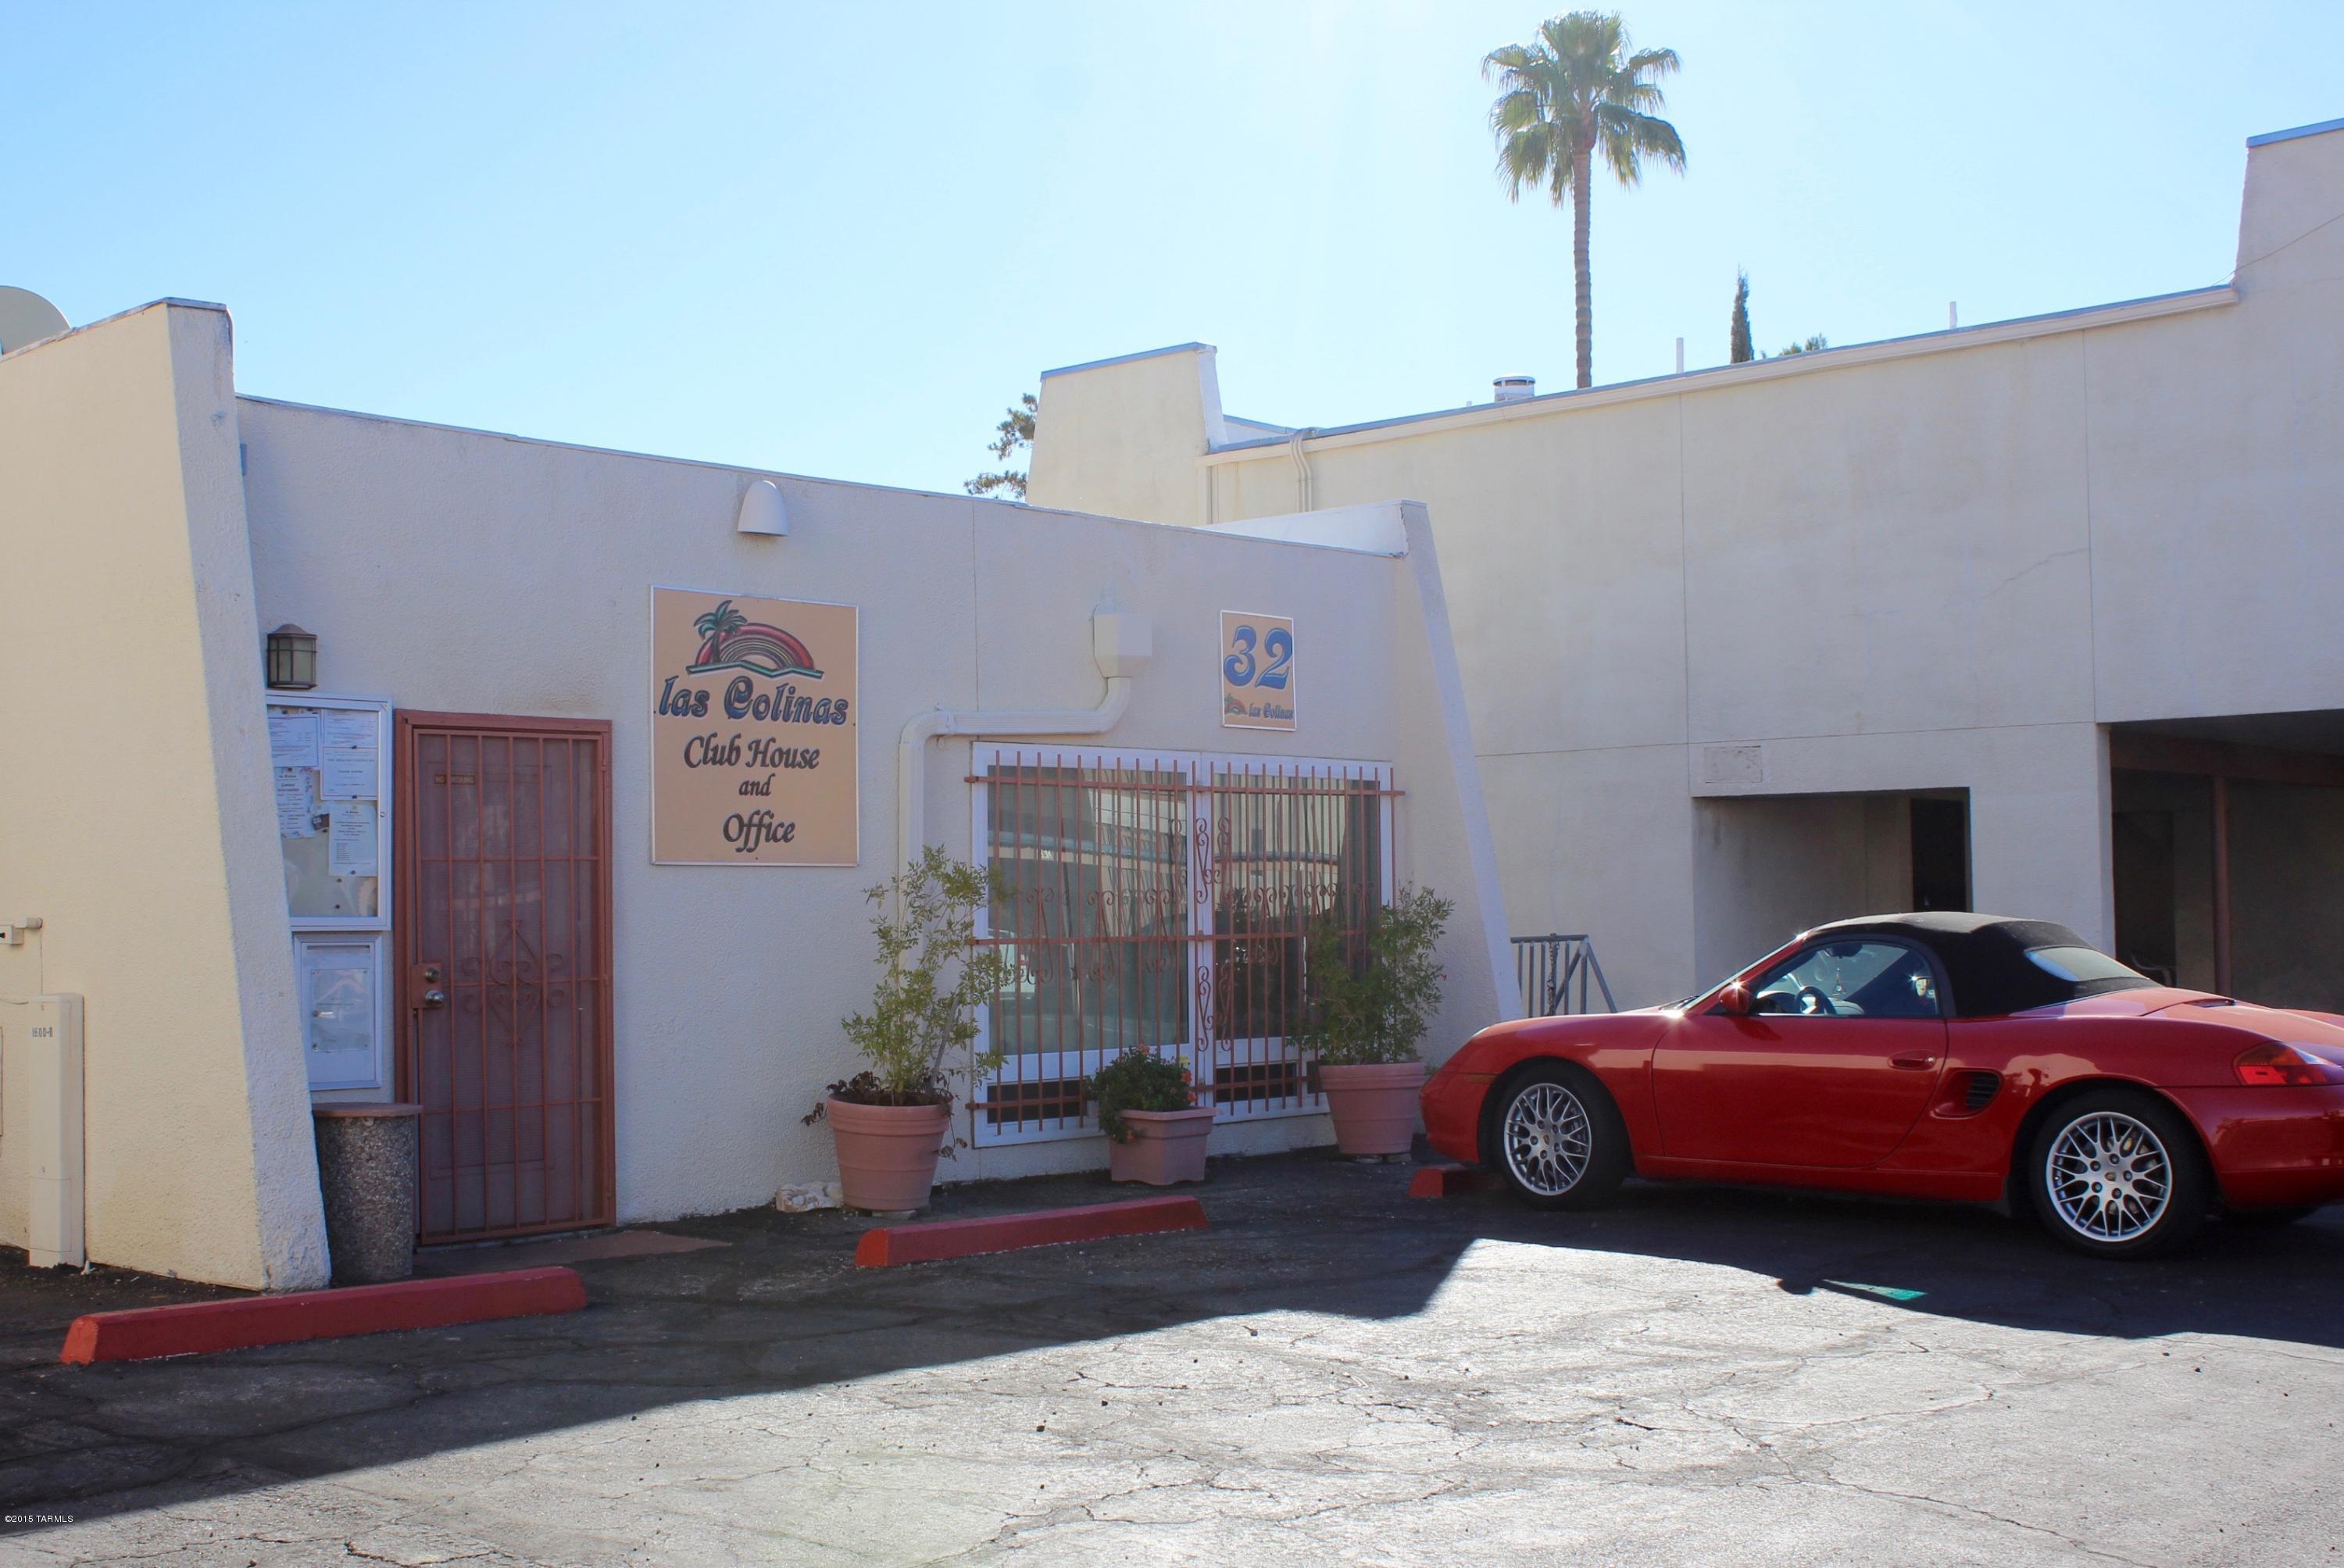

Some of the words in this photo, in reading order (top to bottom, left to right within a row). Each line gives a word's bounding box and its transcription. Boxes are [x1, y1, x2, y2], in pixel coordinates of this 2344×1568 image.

[1224, 625, 1293, 690] 32
[659, 675, 710, 717] las
[724, 675, 849, 725] Colinas
[684, 732, 741, 769] Club
[745, 737, 820, 770] House
[738, 773, 776, 796] and
[723, 809, 795, 852] Office
